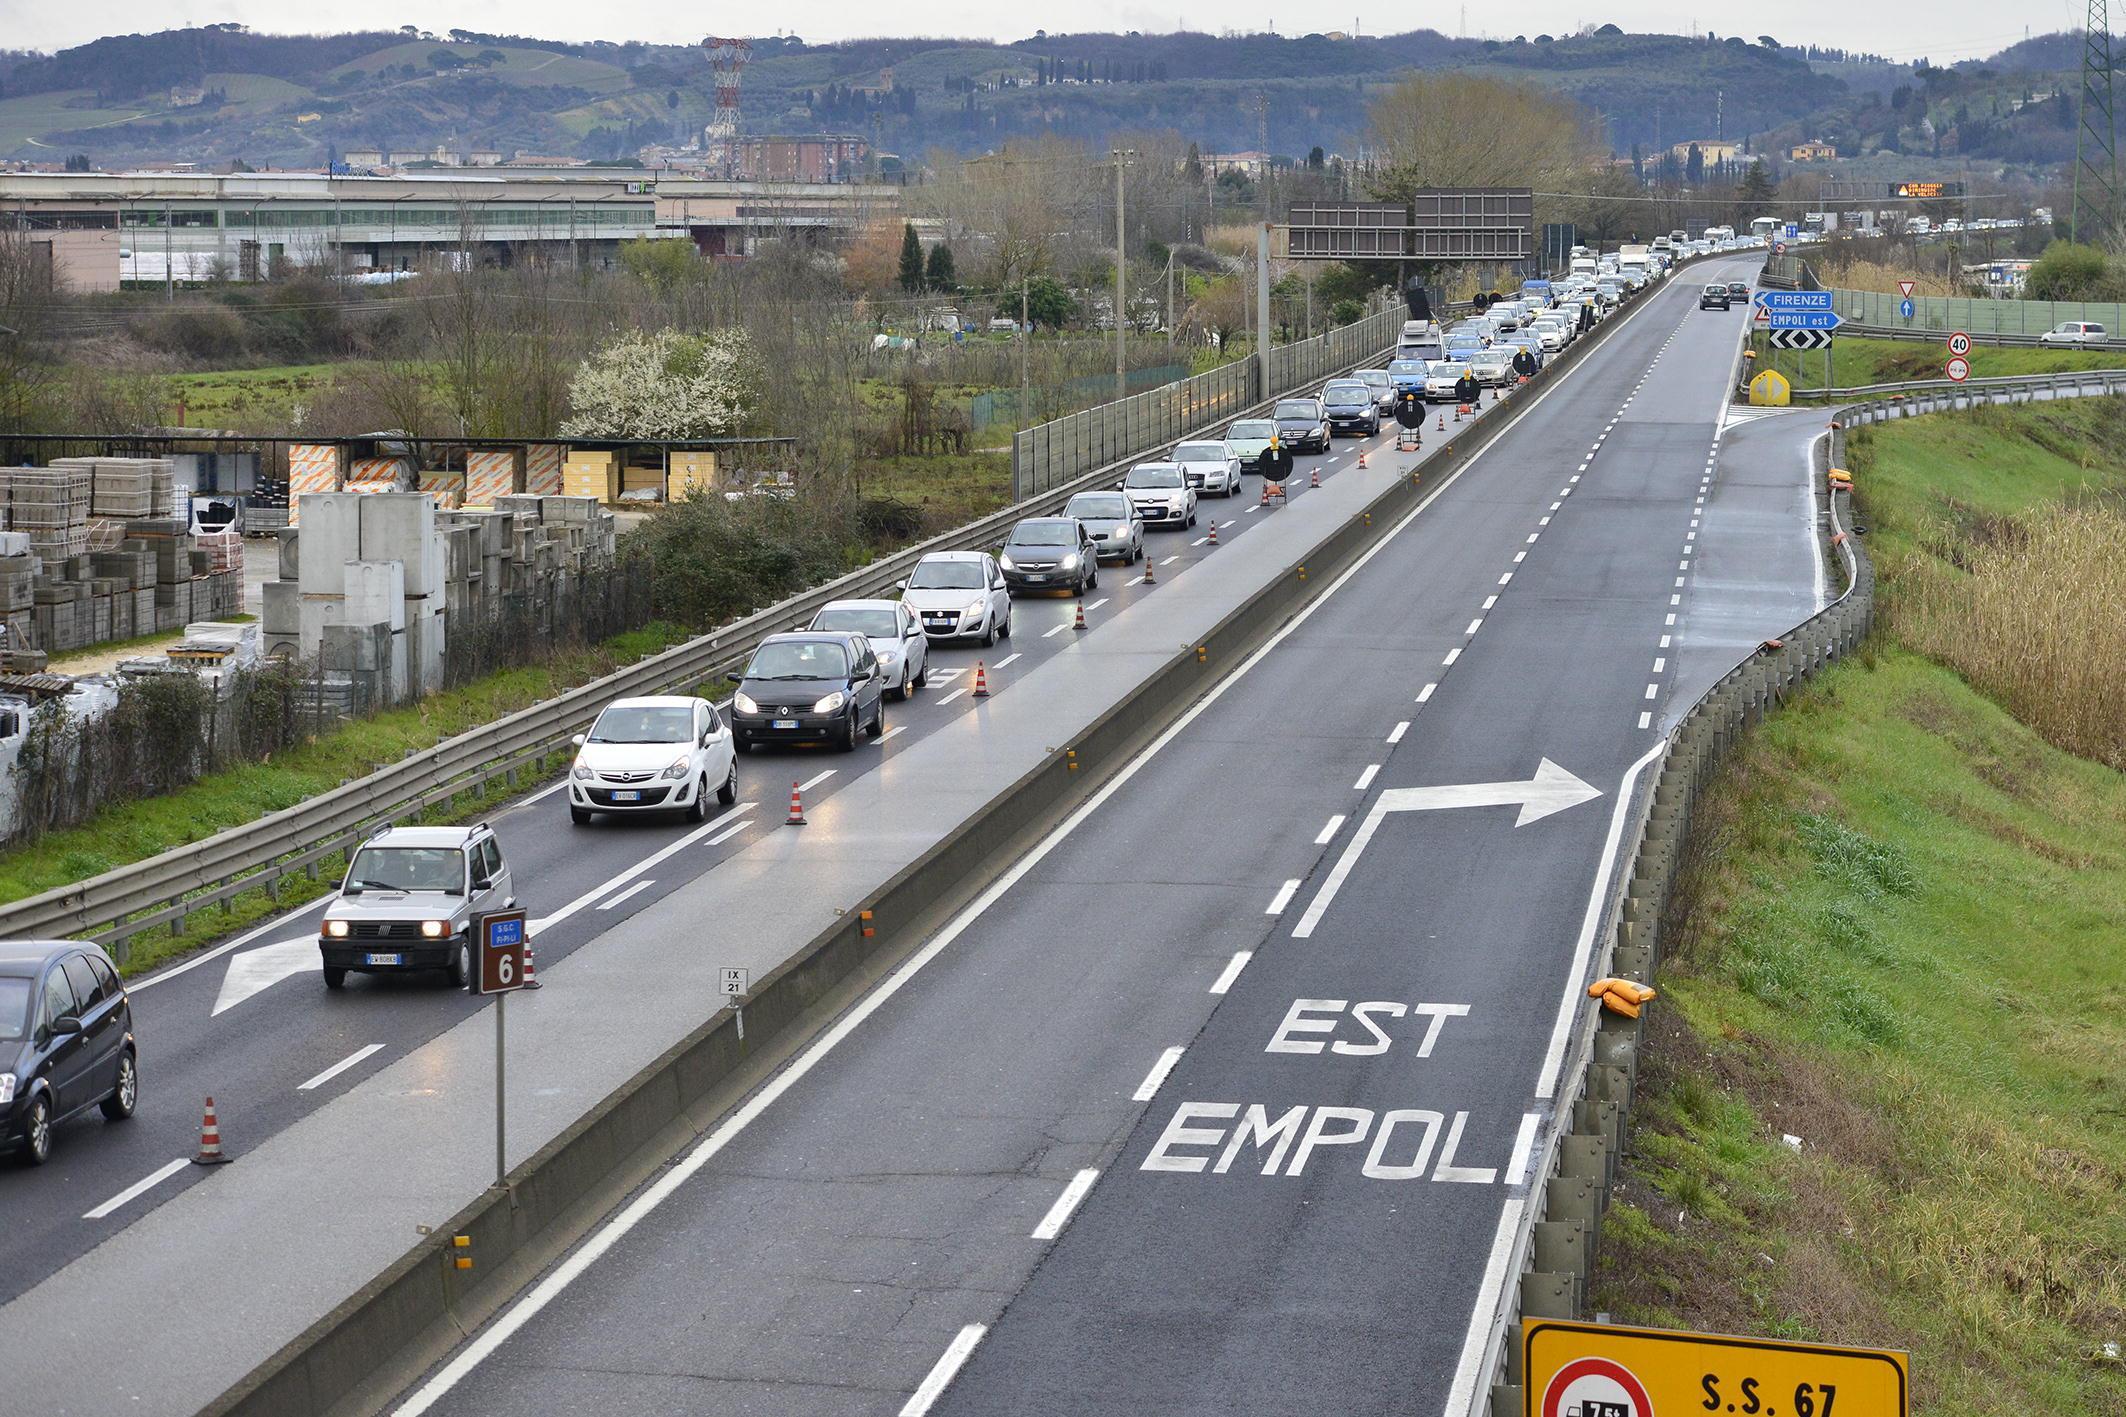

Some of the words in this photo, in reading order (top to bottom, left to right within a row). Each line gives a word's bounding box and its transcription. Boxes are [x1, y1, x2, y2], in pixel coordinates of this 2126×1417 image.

[1773, 295, 1827, 306] FIRENZE
[1772, 315, 1806, 326] EMPOLI
[1811, 315, 1828, 326] est
[1952, 338, 1967, 351] 40
[499, 953, 514, 984] 6
[728, 970, 739, 979] IX
[728, 983, 739, 992] 21
[1264, 998, 1472, 1059] EST
[1701, 1373, 1776, 1417] S.S.
[1794, 1382, 1836, 1417] 67
